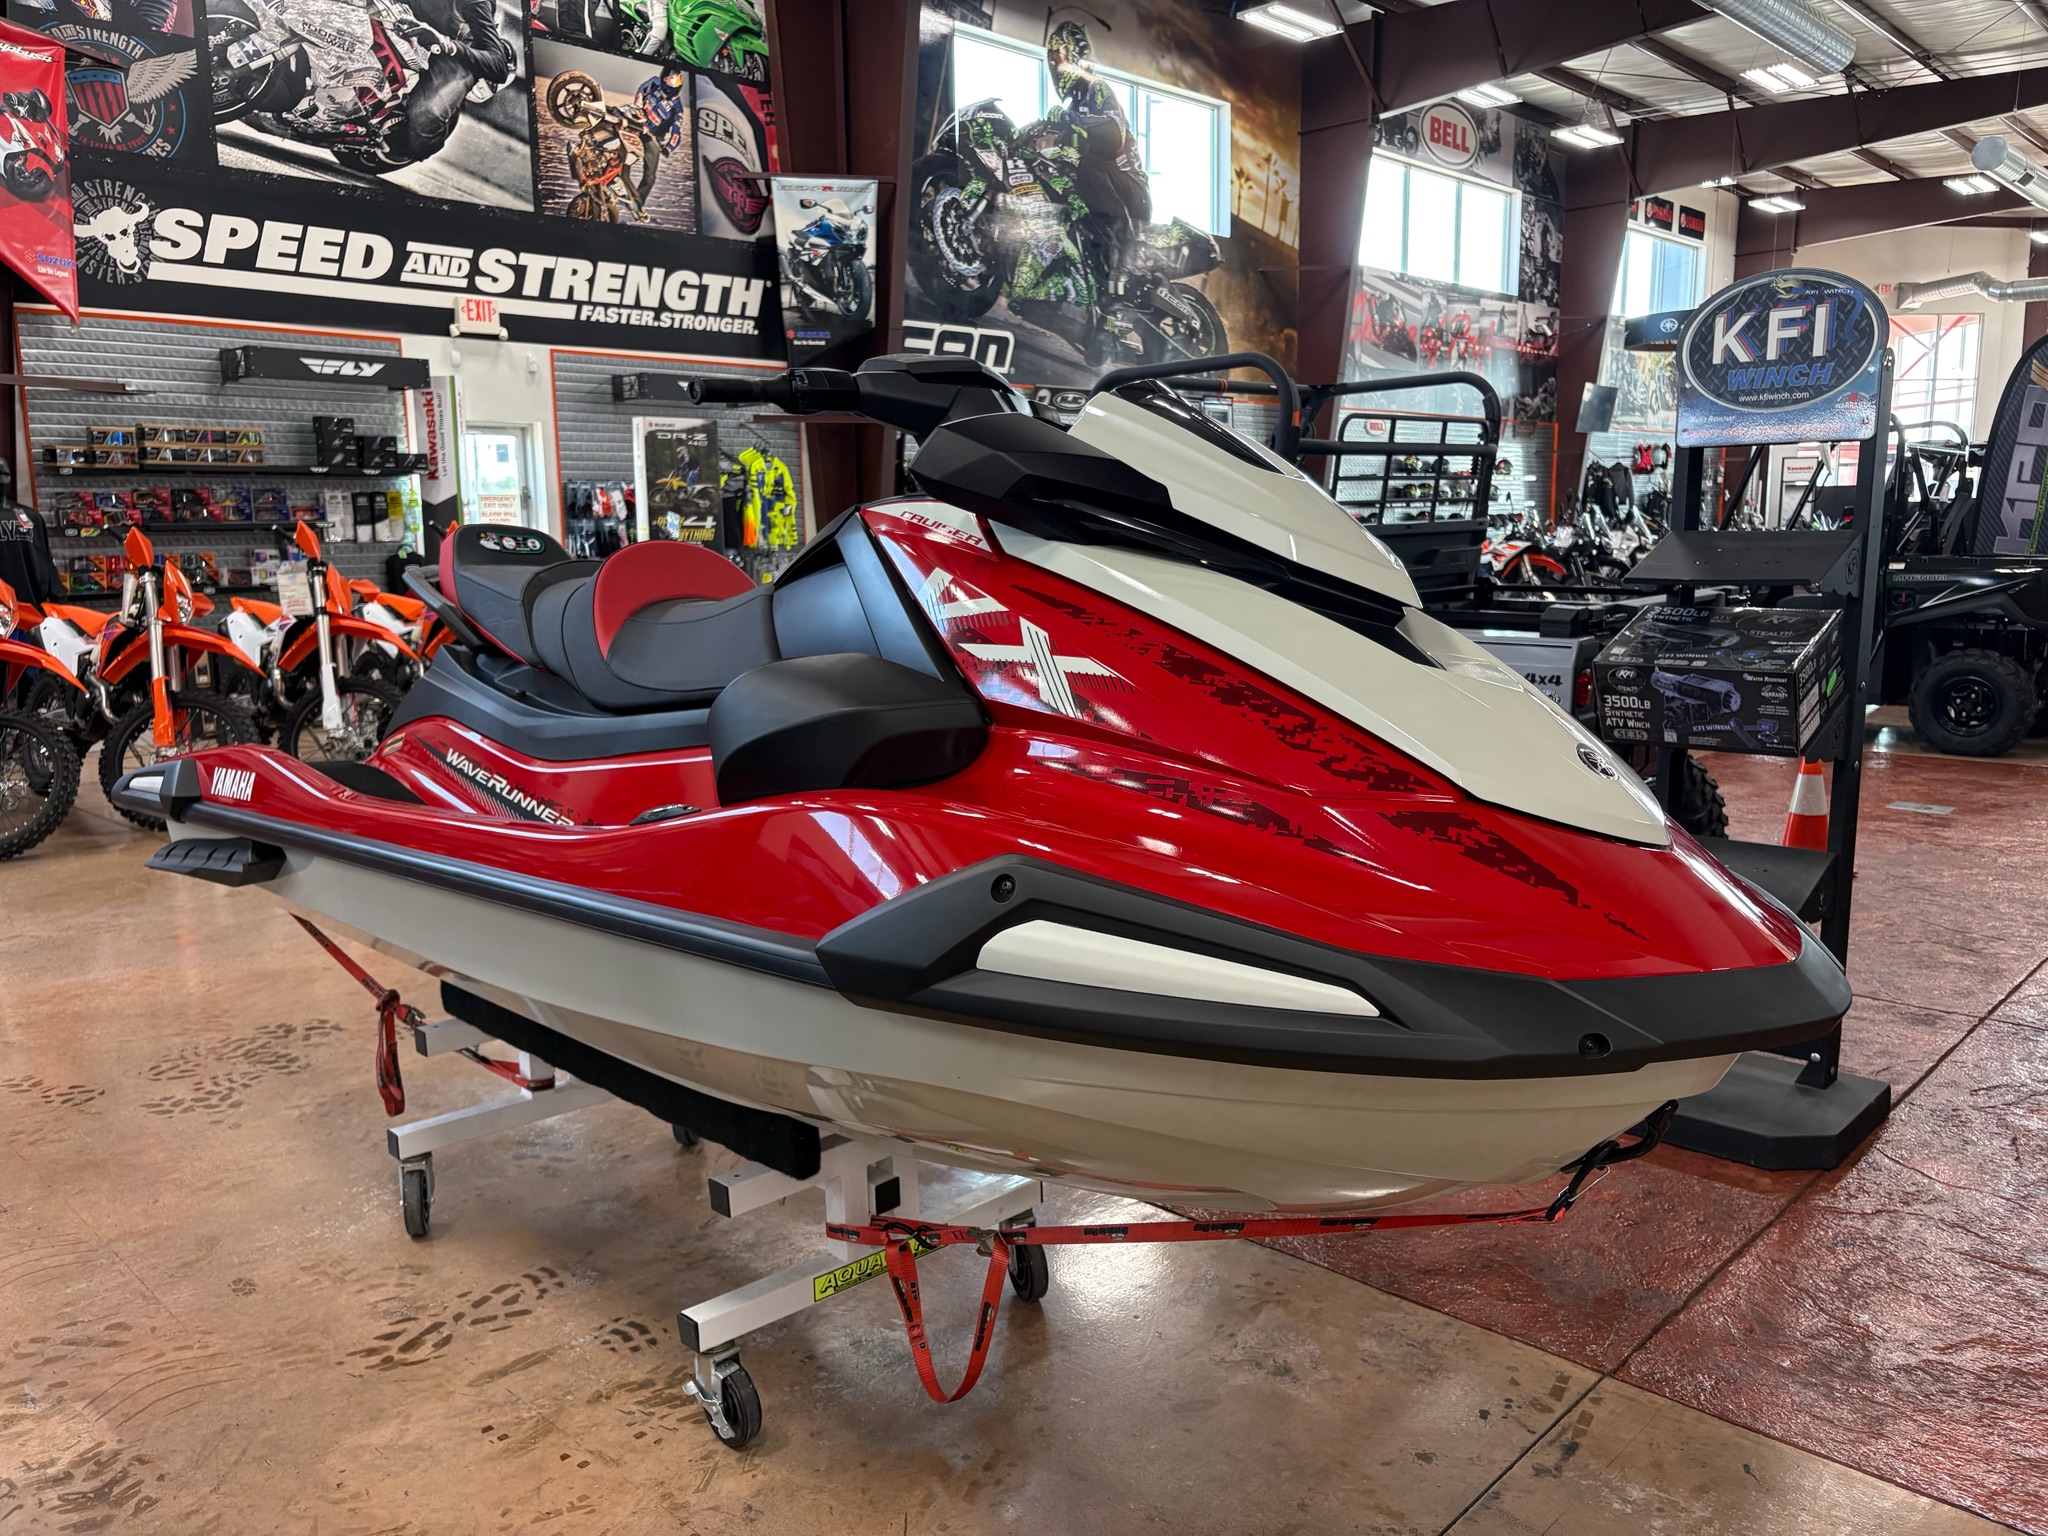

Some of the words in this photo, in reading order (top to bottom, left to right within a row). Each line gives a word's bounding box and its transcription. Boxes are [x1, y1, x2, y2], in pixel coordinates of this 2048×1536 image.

[76, 25, 144, 59] STRENGTH
[1429, 115, 1471, 154] BELL
[148, 208, 394, 280] SPEED
[403, 254, 470, 279] AND
[474, 247, 766, 318] STRENGTH
[1823, 287, 1855, 296] WINCH
[466, 298, 493, 323] EXIT
[1711, 298, 1838, 366] KFI
[302, 357, 386, 378] FLY
[1727, 362, 1835, 391] WINCH
[1058, 395, 1083, 405] HJC
[1738, 391, 1810, 403] www.kfiwinch.com
[421, 390, 440, 481] Kawasaki
[656, 432, 708, 441] DR-Z
[899, 510, 984, 546] CRUISER
[1892, 573, 1948, 582] MAGNUM
[1651, 606, 1710, 618] 3500LB
[1524, 672, 1563, 687] 4x4
[1619, 669, 1635, 679] KFI
[1603, 695, 1651, 709] 3500LB
[1605, 707, 1645, 719] SYNTHETIC
[1606, 717, 1624, 727] ATV
[1626, 718, 1651, 729] WINCH
[211, 766, 256, 802] YAMAHA
[820, 1252, 884, 1294] AQUA
